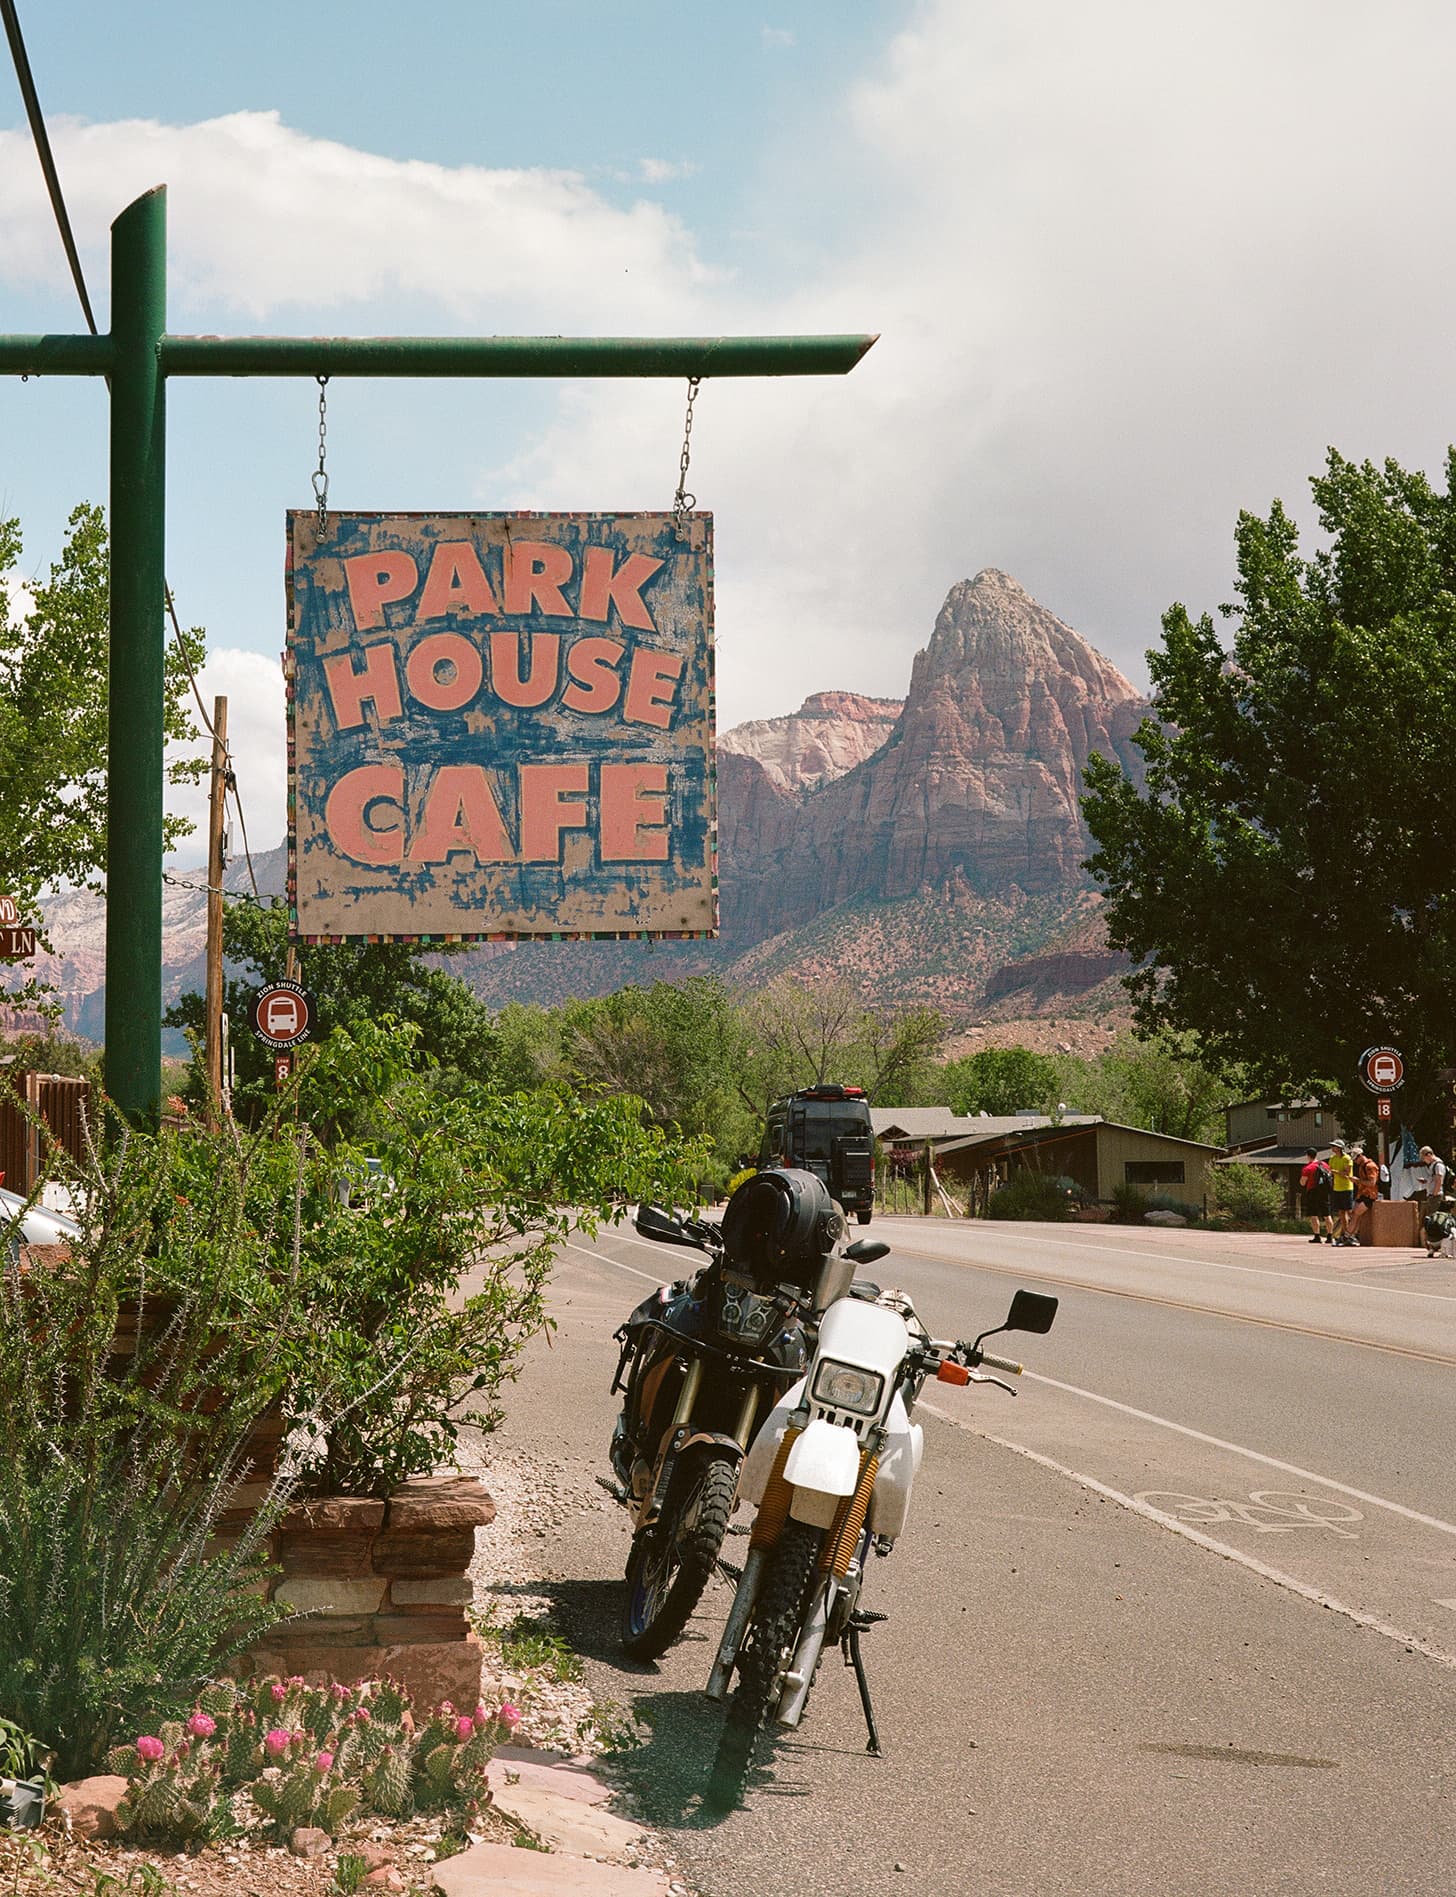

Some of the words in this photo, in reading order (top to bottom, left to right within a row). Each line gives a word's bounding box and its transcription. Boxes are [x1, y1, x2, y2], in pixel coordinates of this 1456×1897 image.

[343, 541, 664, 632] PARK
[322, 633, 684, 731] HOUSE
[325, 765, 670, 866] CAFE
[11, 931, 32, 953] LN
[256, 983, 274, 998] ZION
[276, 982, 308, 997] SHUTTLE
[254, 1030, 296, 1049] SPRINGDALE
[296, 1028, 311, 1043] LINE
[1380, 1046, 1402, 1057] SHUTTLE
[278, 1065, 288, 1080] 8
